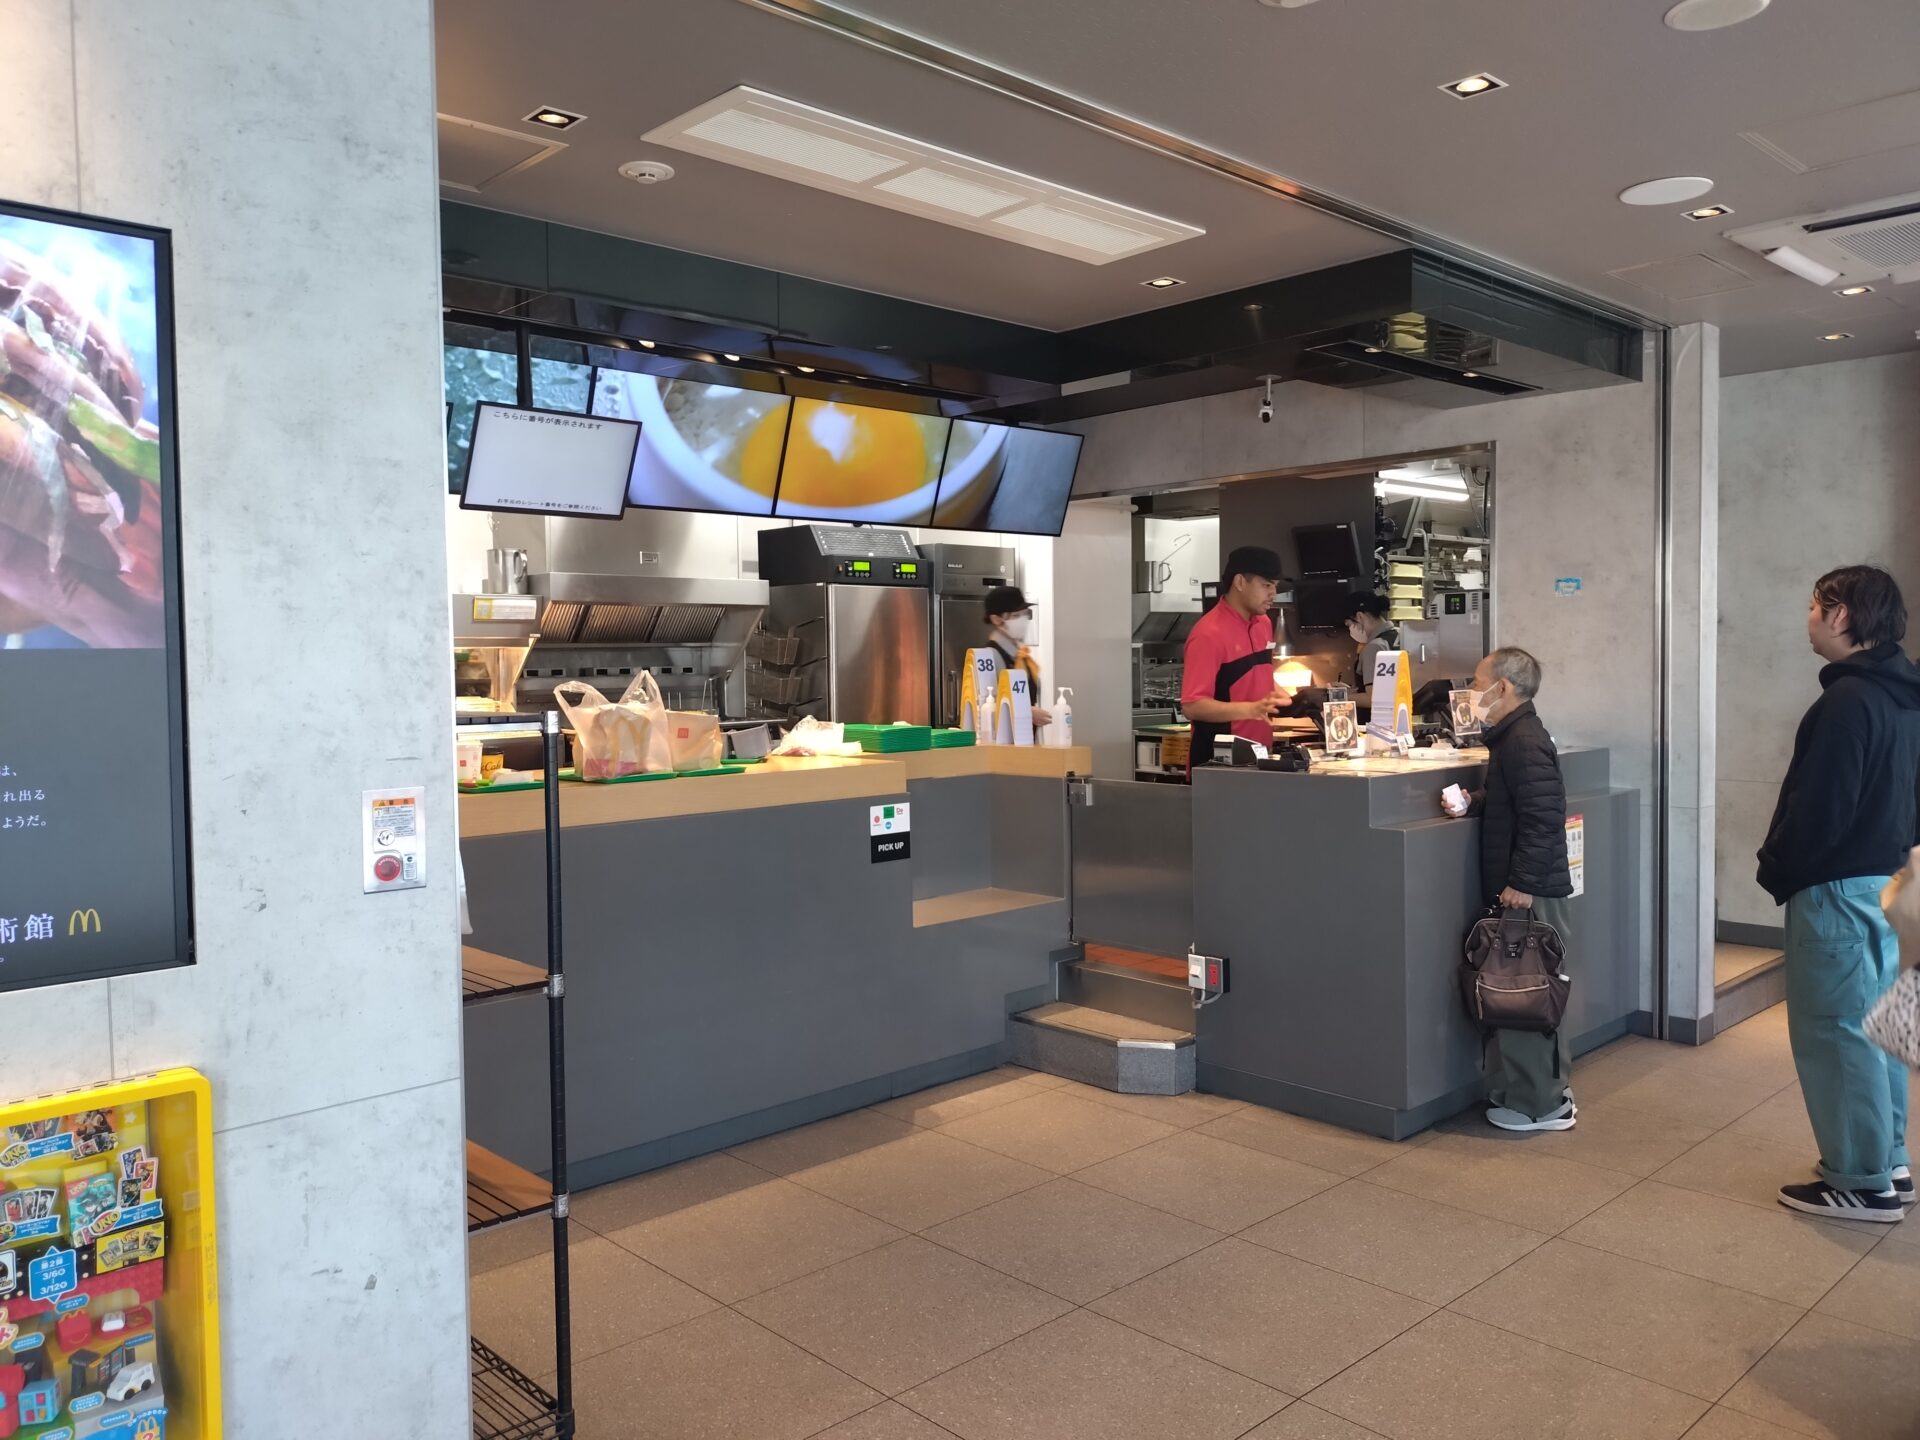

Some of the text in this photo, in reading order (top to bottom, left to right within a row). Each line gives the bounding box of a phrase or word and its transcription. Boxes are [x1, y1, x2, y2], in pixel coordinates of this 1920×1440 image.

[493, 411, 603, 430] こちらに番号が表示されます
[977, 658, 994, 672] 38
[1376, 662, 1396, 677] 24
[1012, 680, 1026, 694] 47
[878, 841, 905, 852] PICK UP
[91, 1211, 119, 1234] UNO
